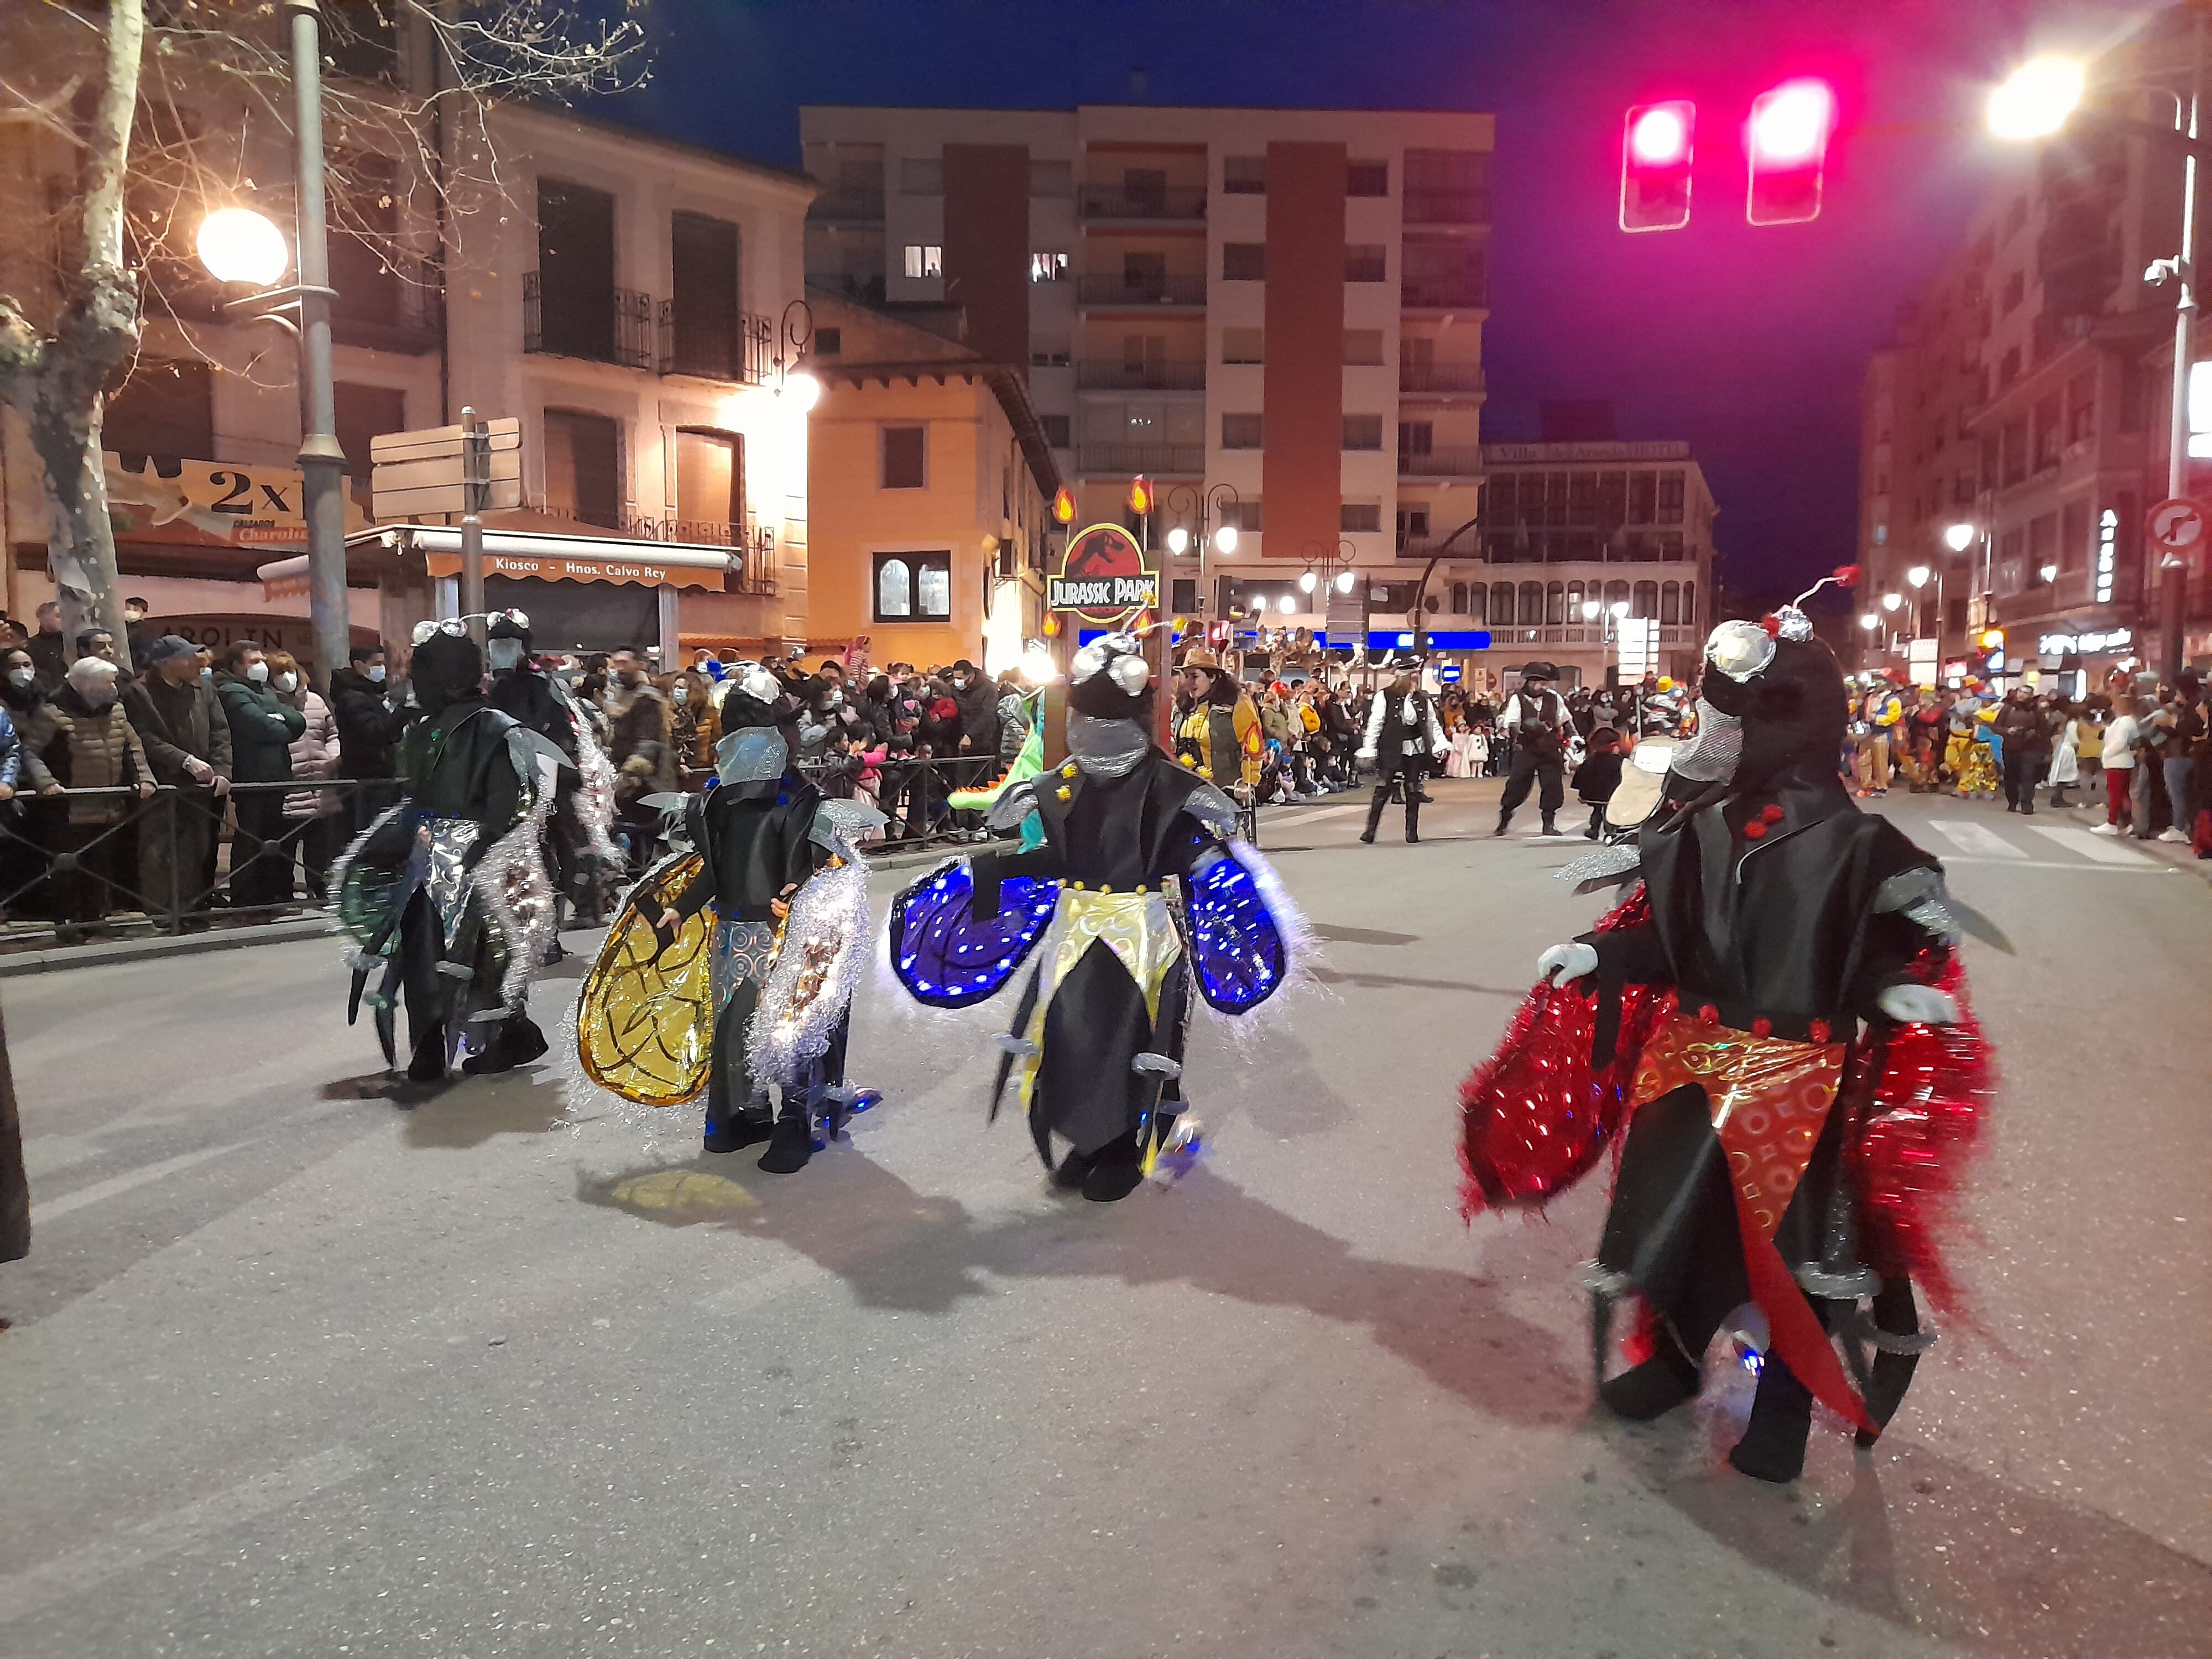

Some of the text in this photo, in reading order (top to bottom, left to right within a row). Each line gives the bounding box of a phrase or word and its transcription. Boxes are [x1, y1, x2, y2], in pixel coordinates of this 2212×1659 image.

[495, 558, 539, 571] Kiosco
[566, 562, 601, 575] Hnos.
[606, 565, 640, 577] Calvo
[644, 567, 666, 580] Rey
[1051, 577, 1155, 607] JURASSIC PARK
